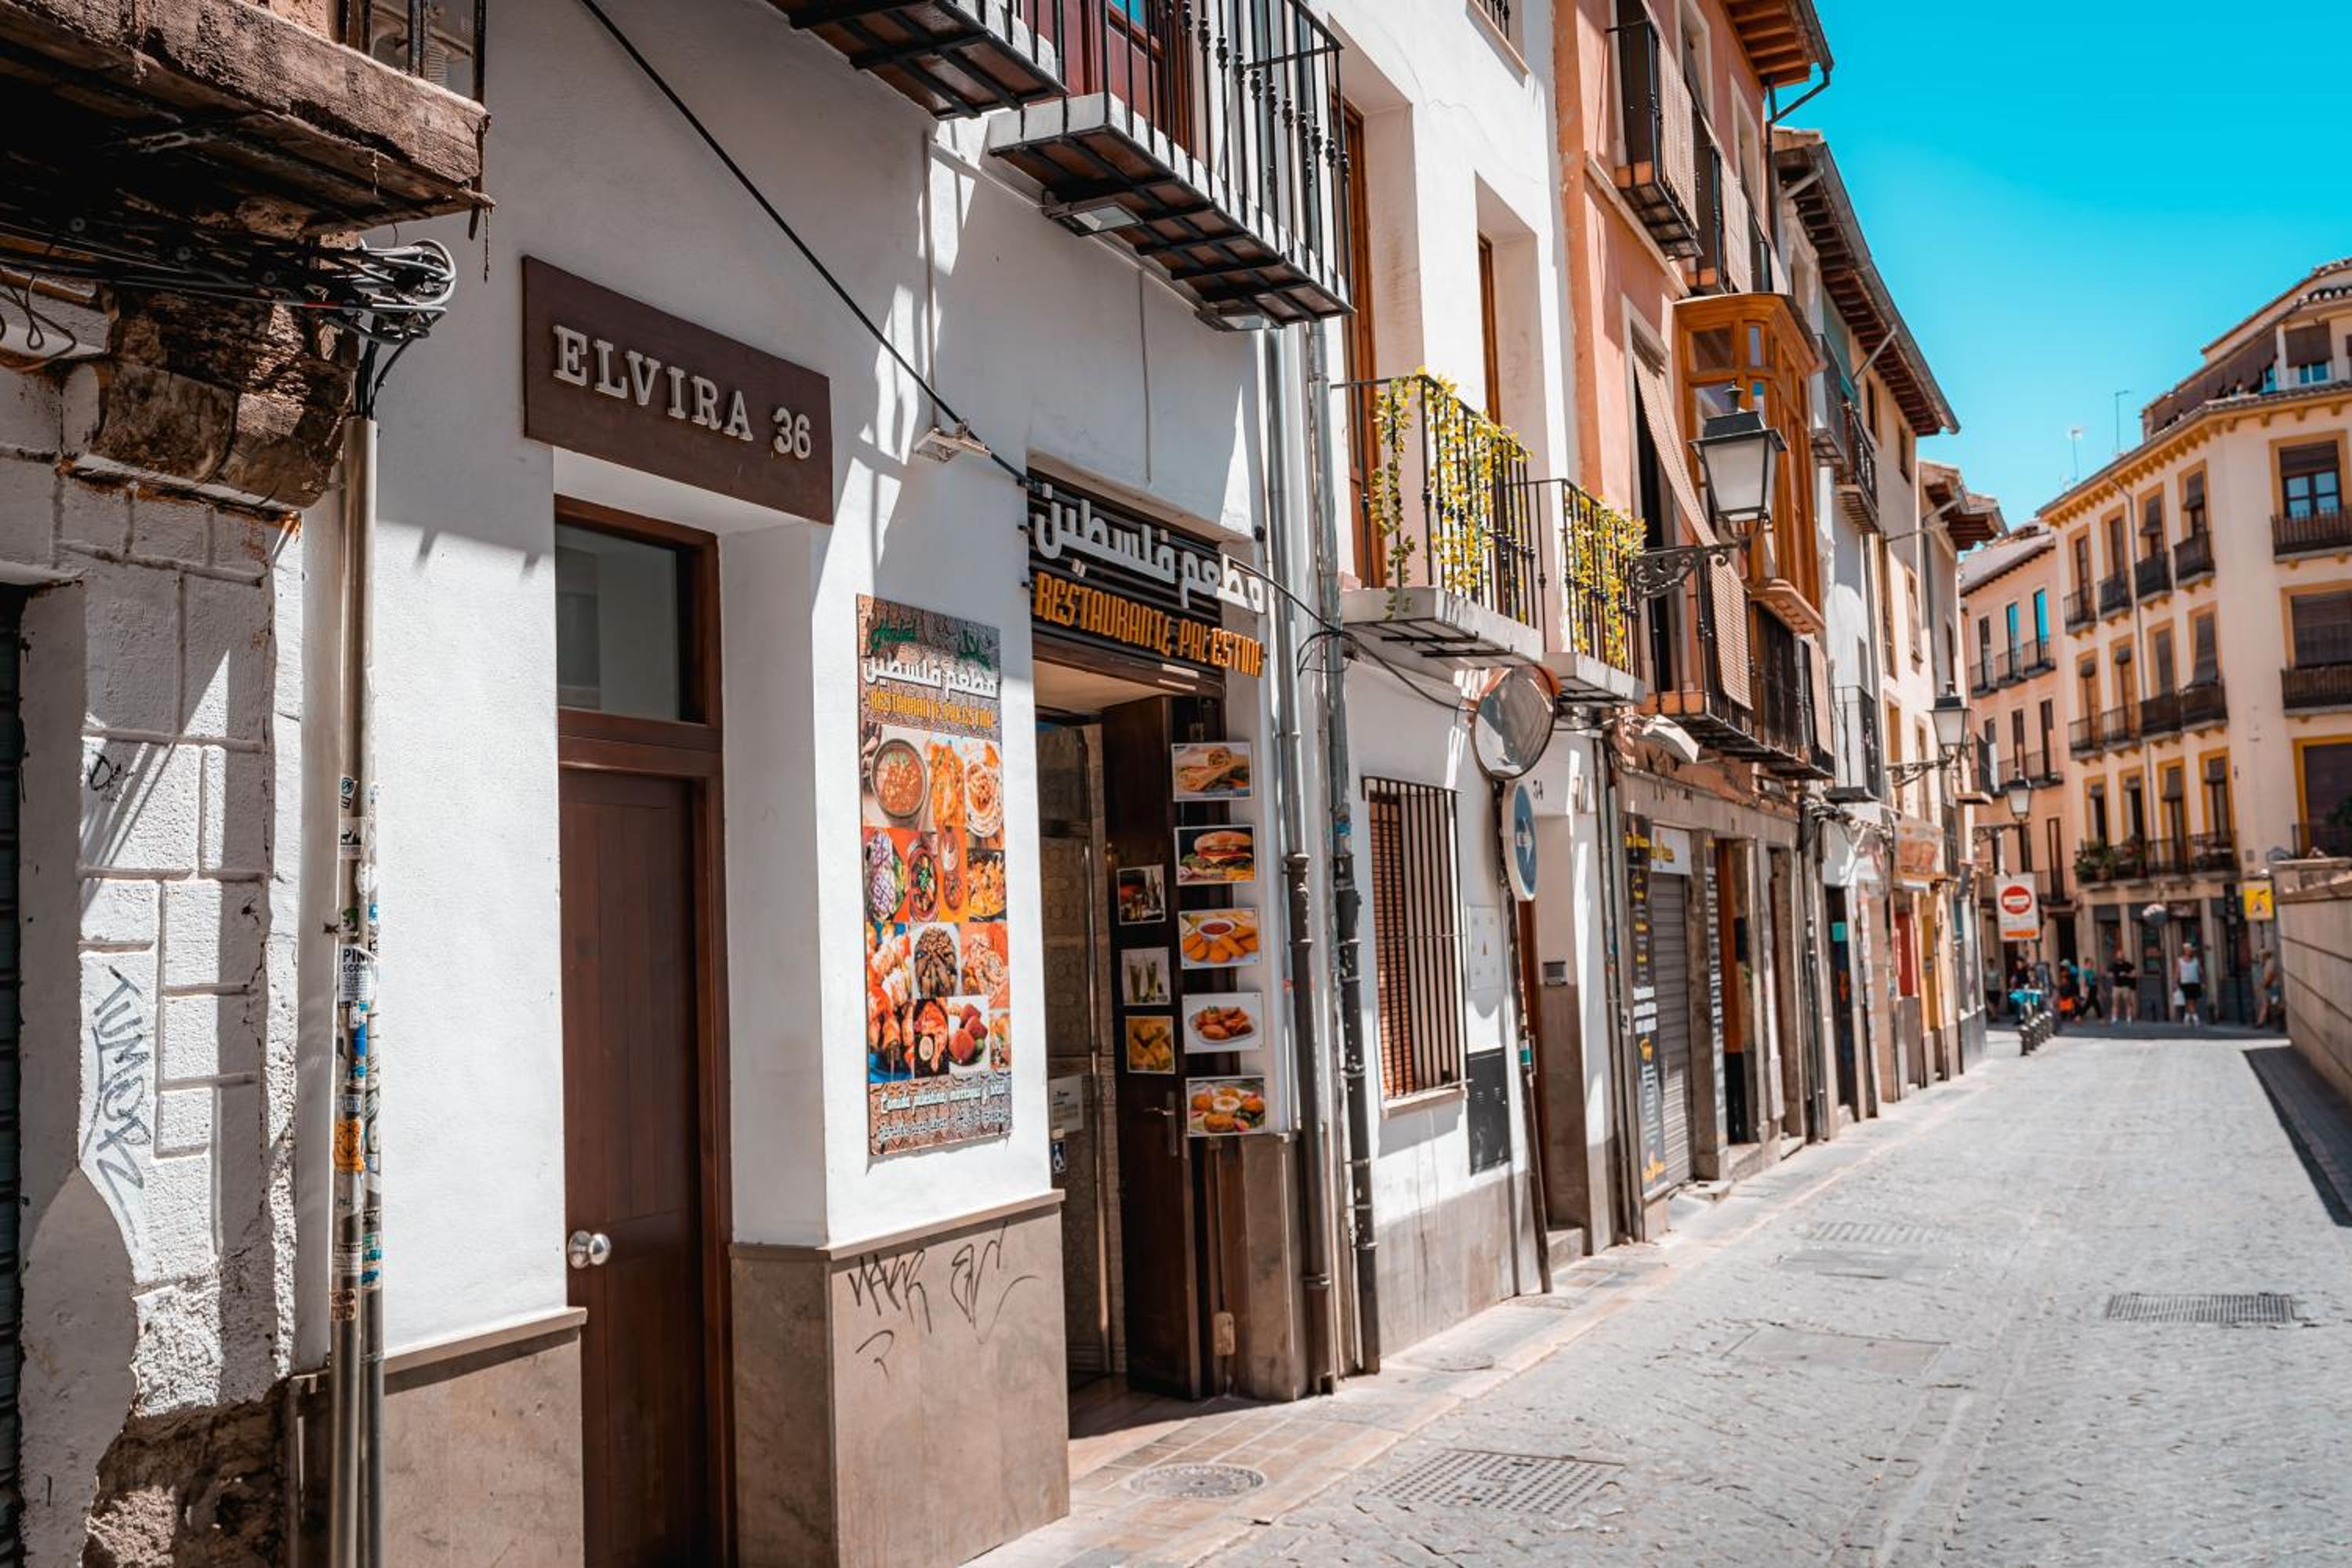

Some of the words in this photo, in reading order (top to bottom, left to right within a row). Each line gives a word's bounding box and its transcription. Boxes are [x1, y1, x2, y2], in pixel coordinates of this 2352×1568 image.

[553, 324, 753, 441] ELVIRA
[772, 406, 812, 460] 36
[1033, 482, 1175, 585] فلسطين
[1179, 550, 1265, 614] مطعم
